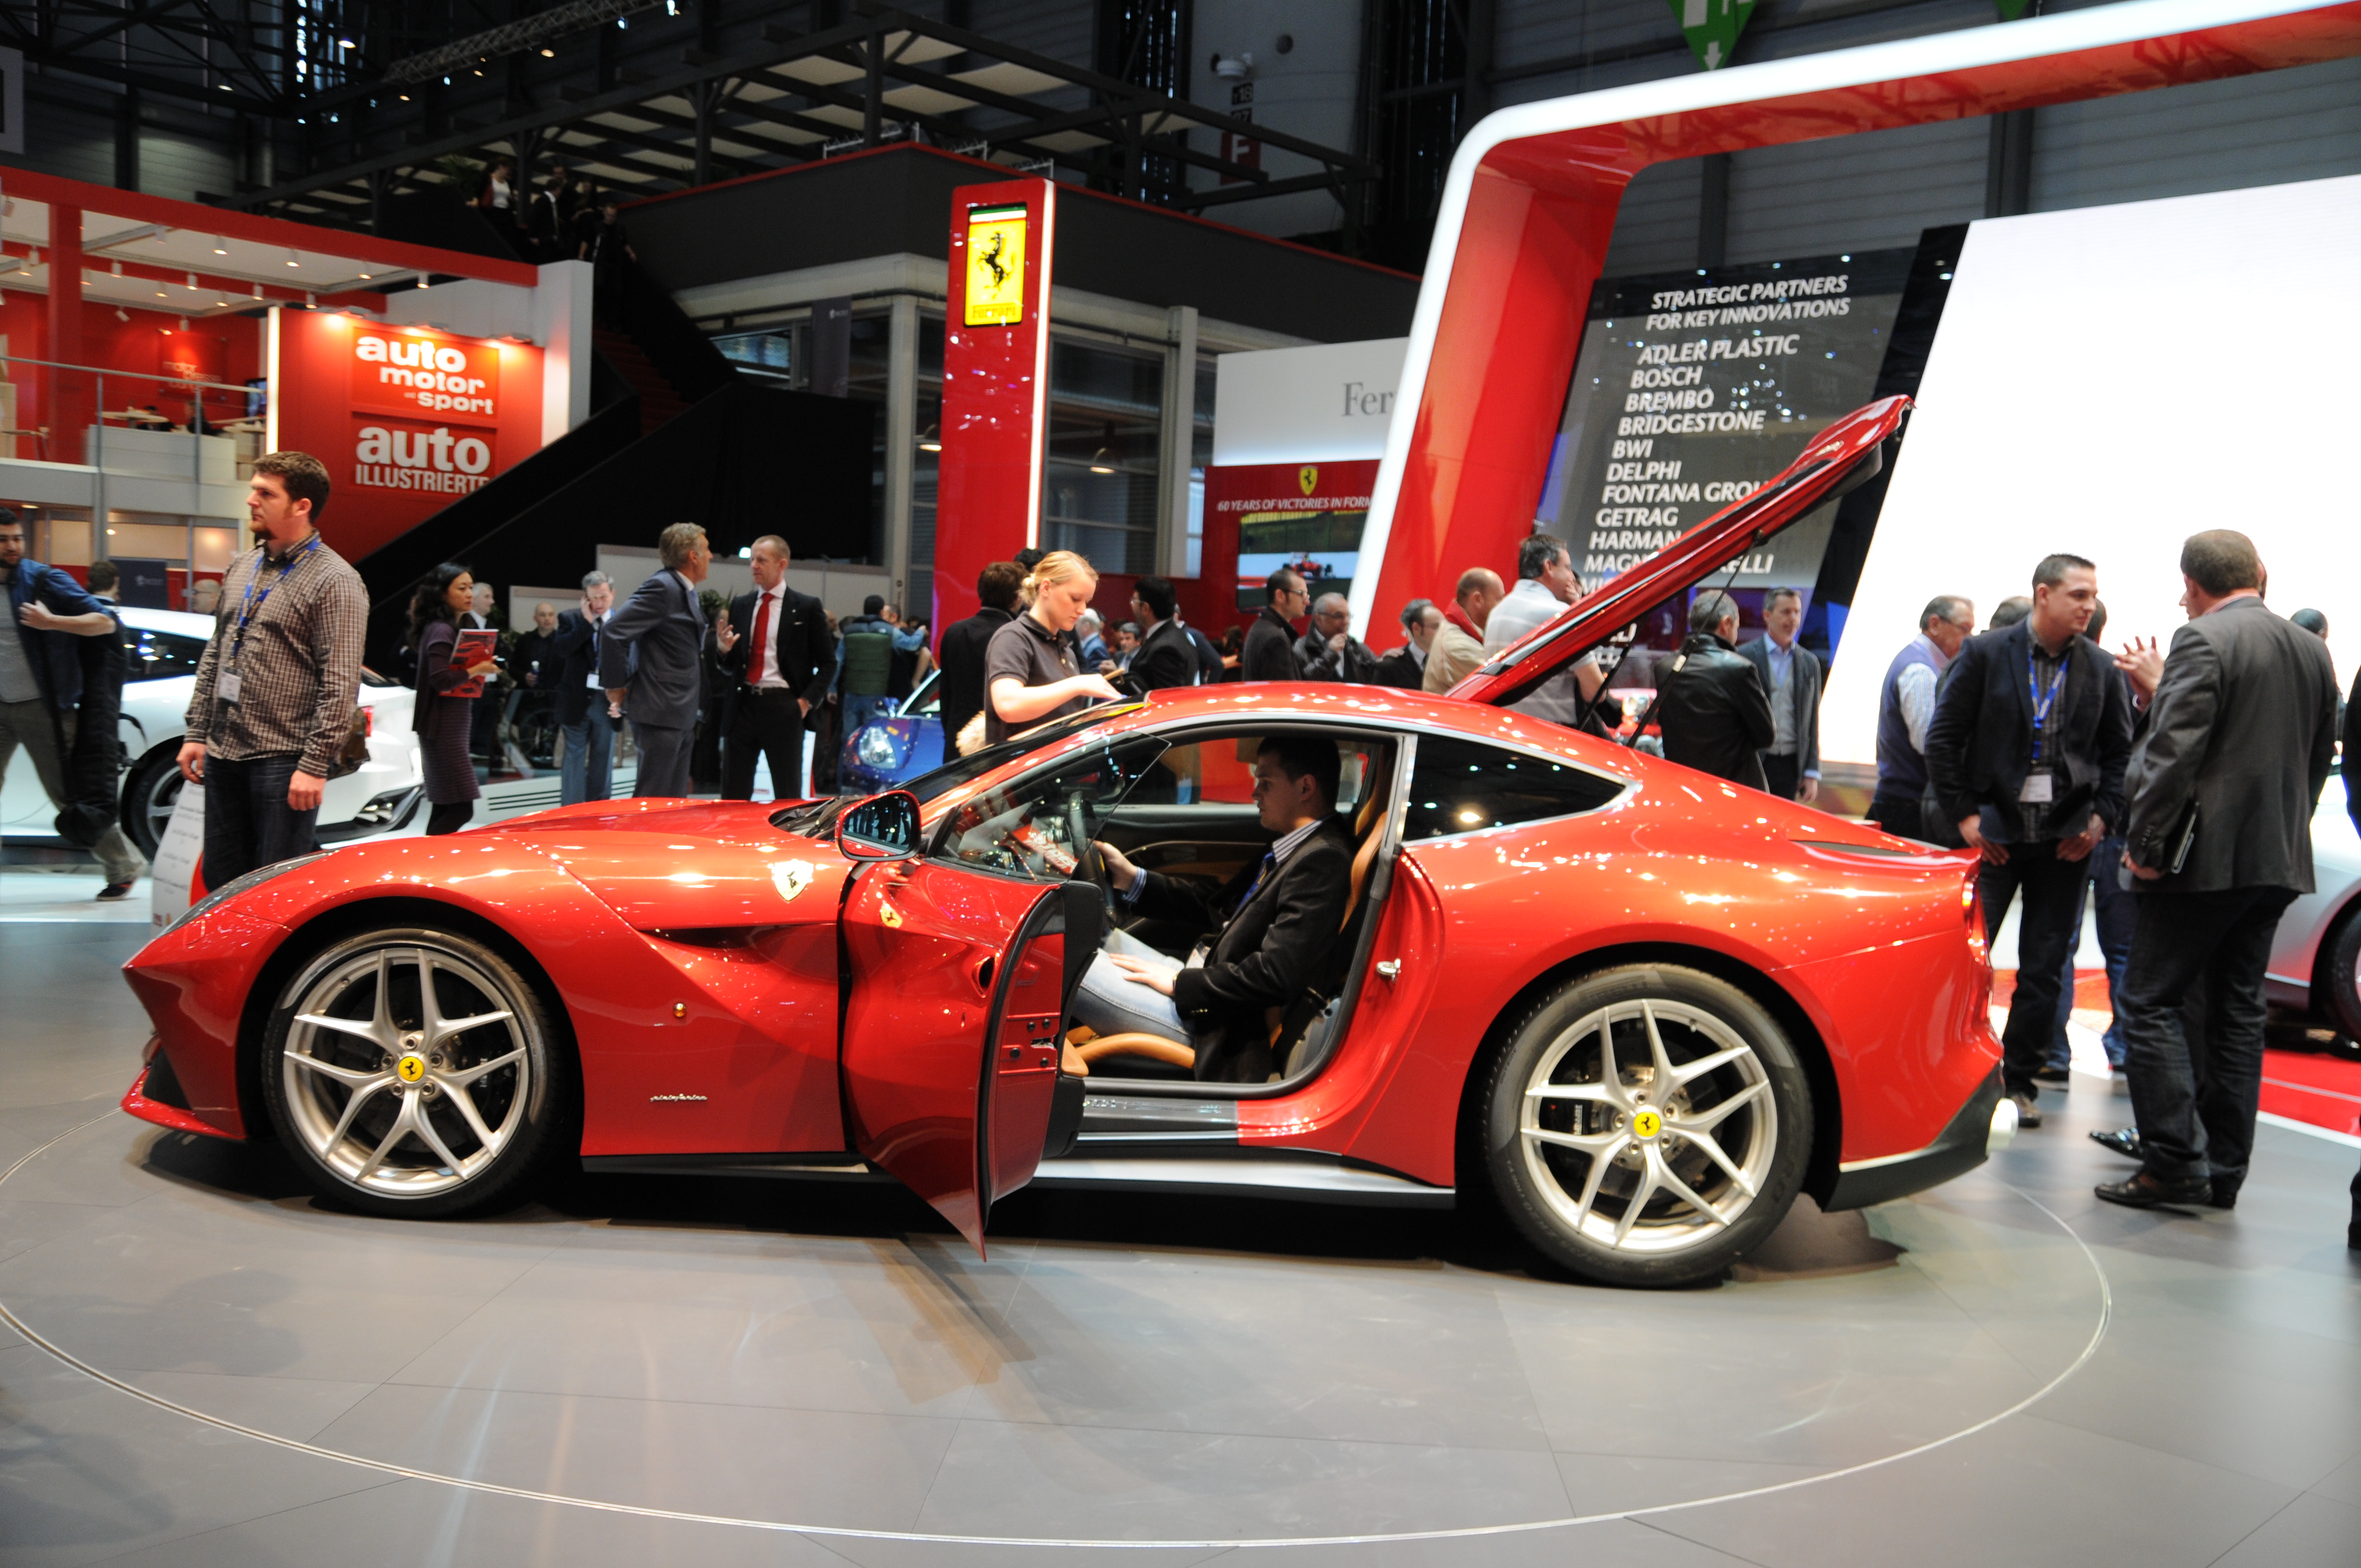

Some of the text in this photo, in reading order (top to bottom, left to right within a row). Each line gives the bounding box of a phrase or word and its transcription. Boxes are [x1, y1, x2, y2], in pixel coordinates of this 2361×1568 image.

[1651, 275, 1849, 310] STRATEGIC PARTNERS
[1645, 298, 1851, 331] FOR KEY INNOVATIONS
[356, 336, 466, 373] auto
[1636, 335, 1800, 366] ADLER PLASTIC
[380, 367, 486, 395] motor
[1630, 366, 1703, 389] BOSCH
[417, 391, 493, 415] sport
[1342, 382, 1397, 417] Fer
[1625, 389, 1715, 413] BREMBO
[1617, 411, 1766, 437] BRIDGESTONE
[356, 426, 491, 475] auto
[1611, 440, 1653, 460] BWI
[1606, 460, 1682, 482] DELPHI
[1217, 500, 1230, 511] 60
[1231, 499, 1261, 511] YEARS
[1262, 498, 1277, 510] OF
[1277, 497, 1329, 510] VICTORIES
[1331, 497, 1342, 508] IN
[1601, 484, 1700, 504] FONTANA
[1596, 507, 1678, 527] GETRAG
[1589, 530, 1682, 550] HARMAN
[1583, 553, 1649, 573] MAGN
